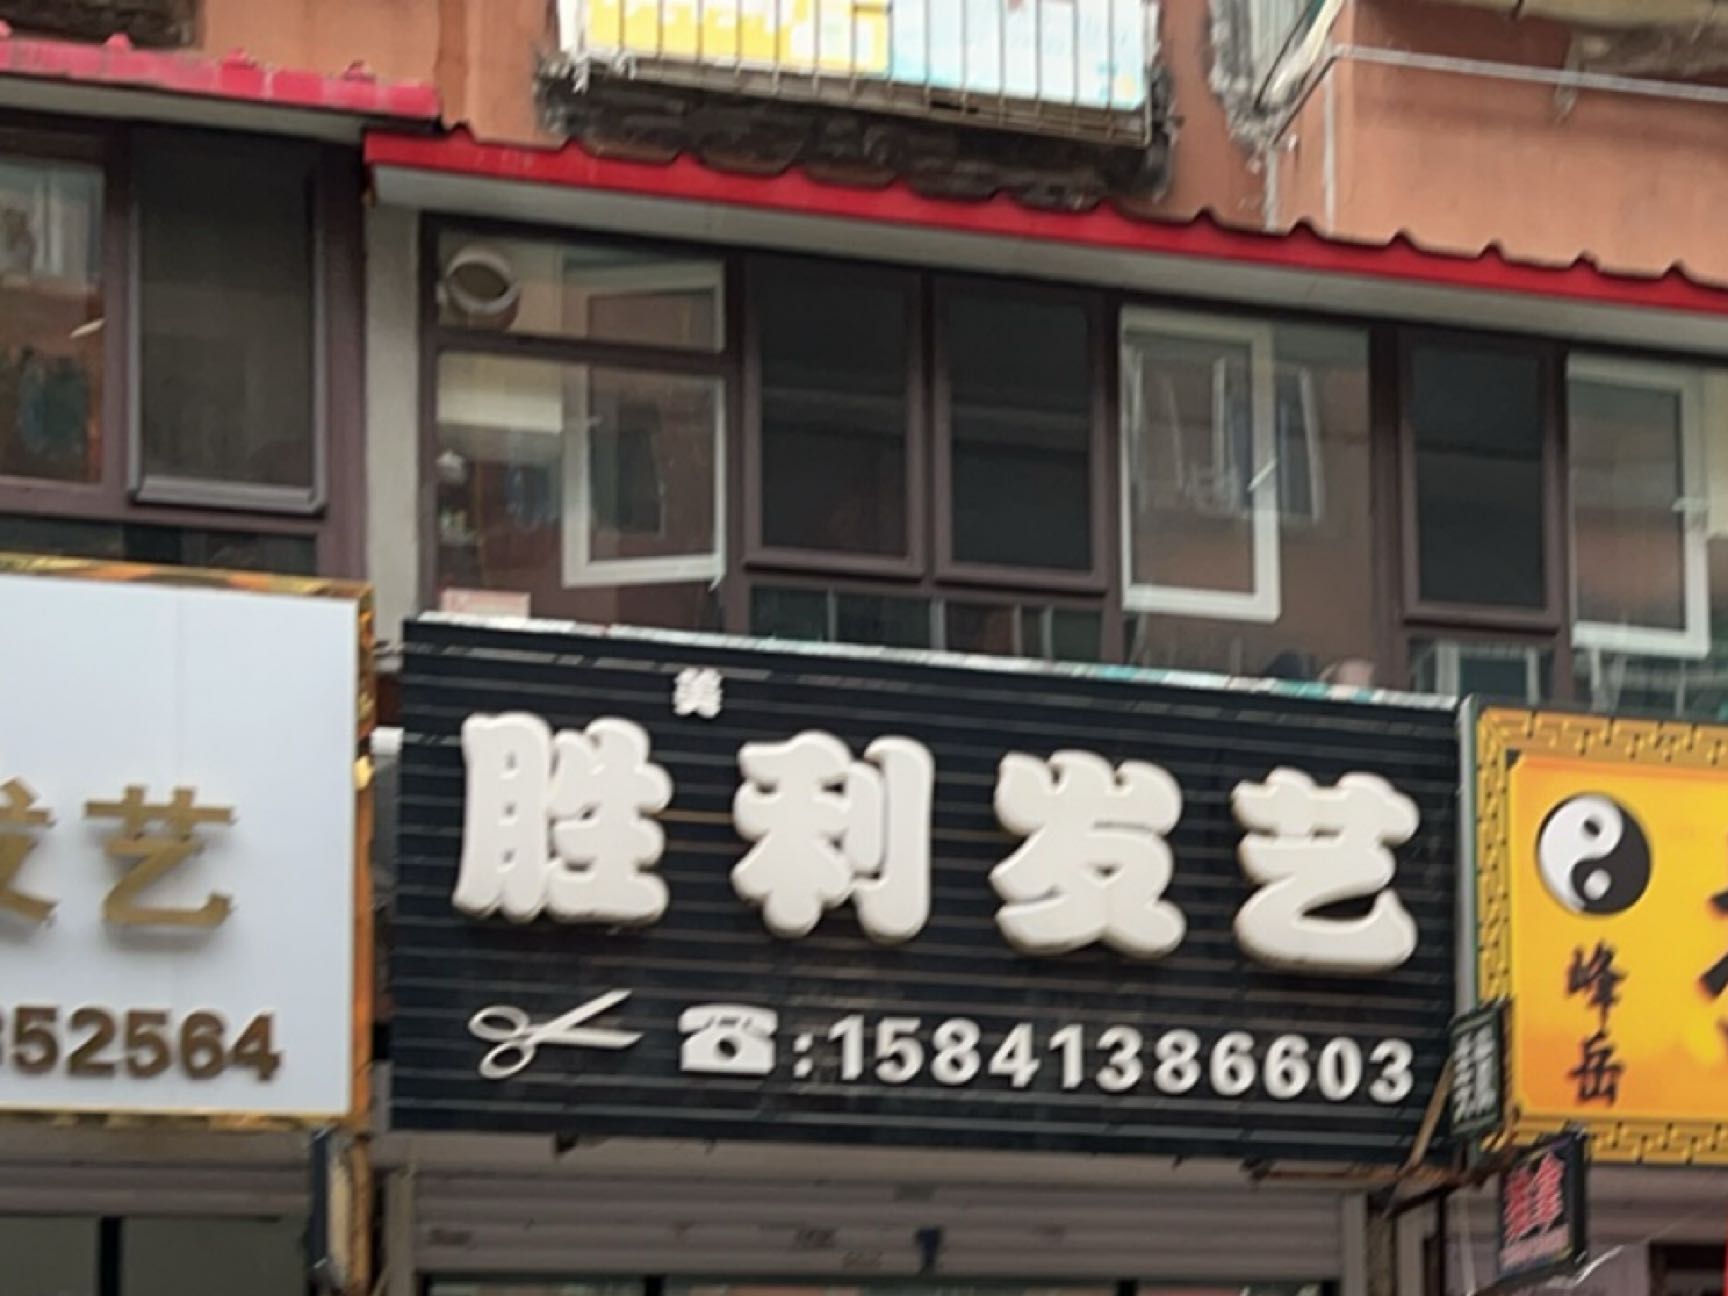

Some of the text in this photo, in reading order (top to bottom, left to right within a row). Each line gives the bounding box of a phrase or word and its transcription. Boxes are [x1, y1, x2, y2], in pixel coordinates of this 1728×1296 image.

[453, 711, 1419, 974] 胜利发艺
[0, 1004, 282, 1083] 52564
[1565, 940, 1628, 1107] 峰岳
